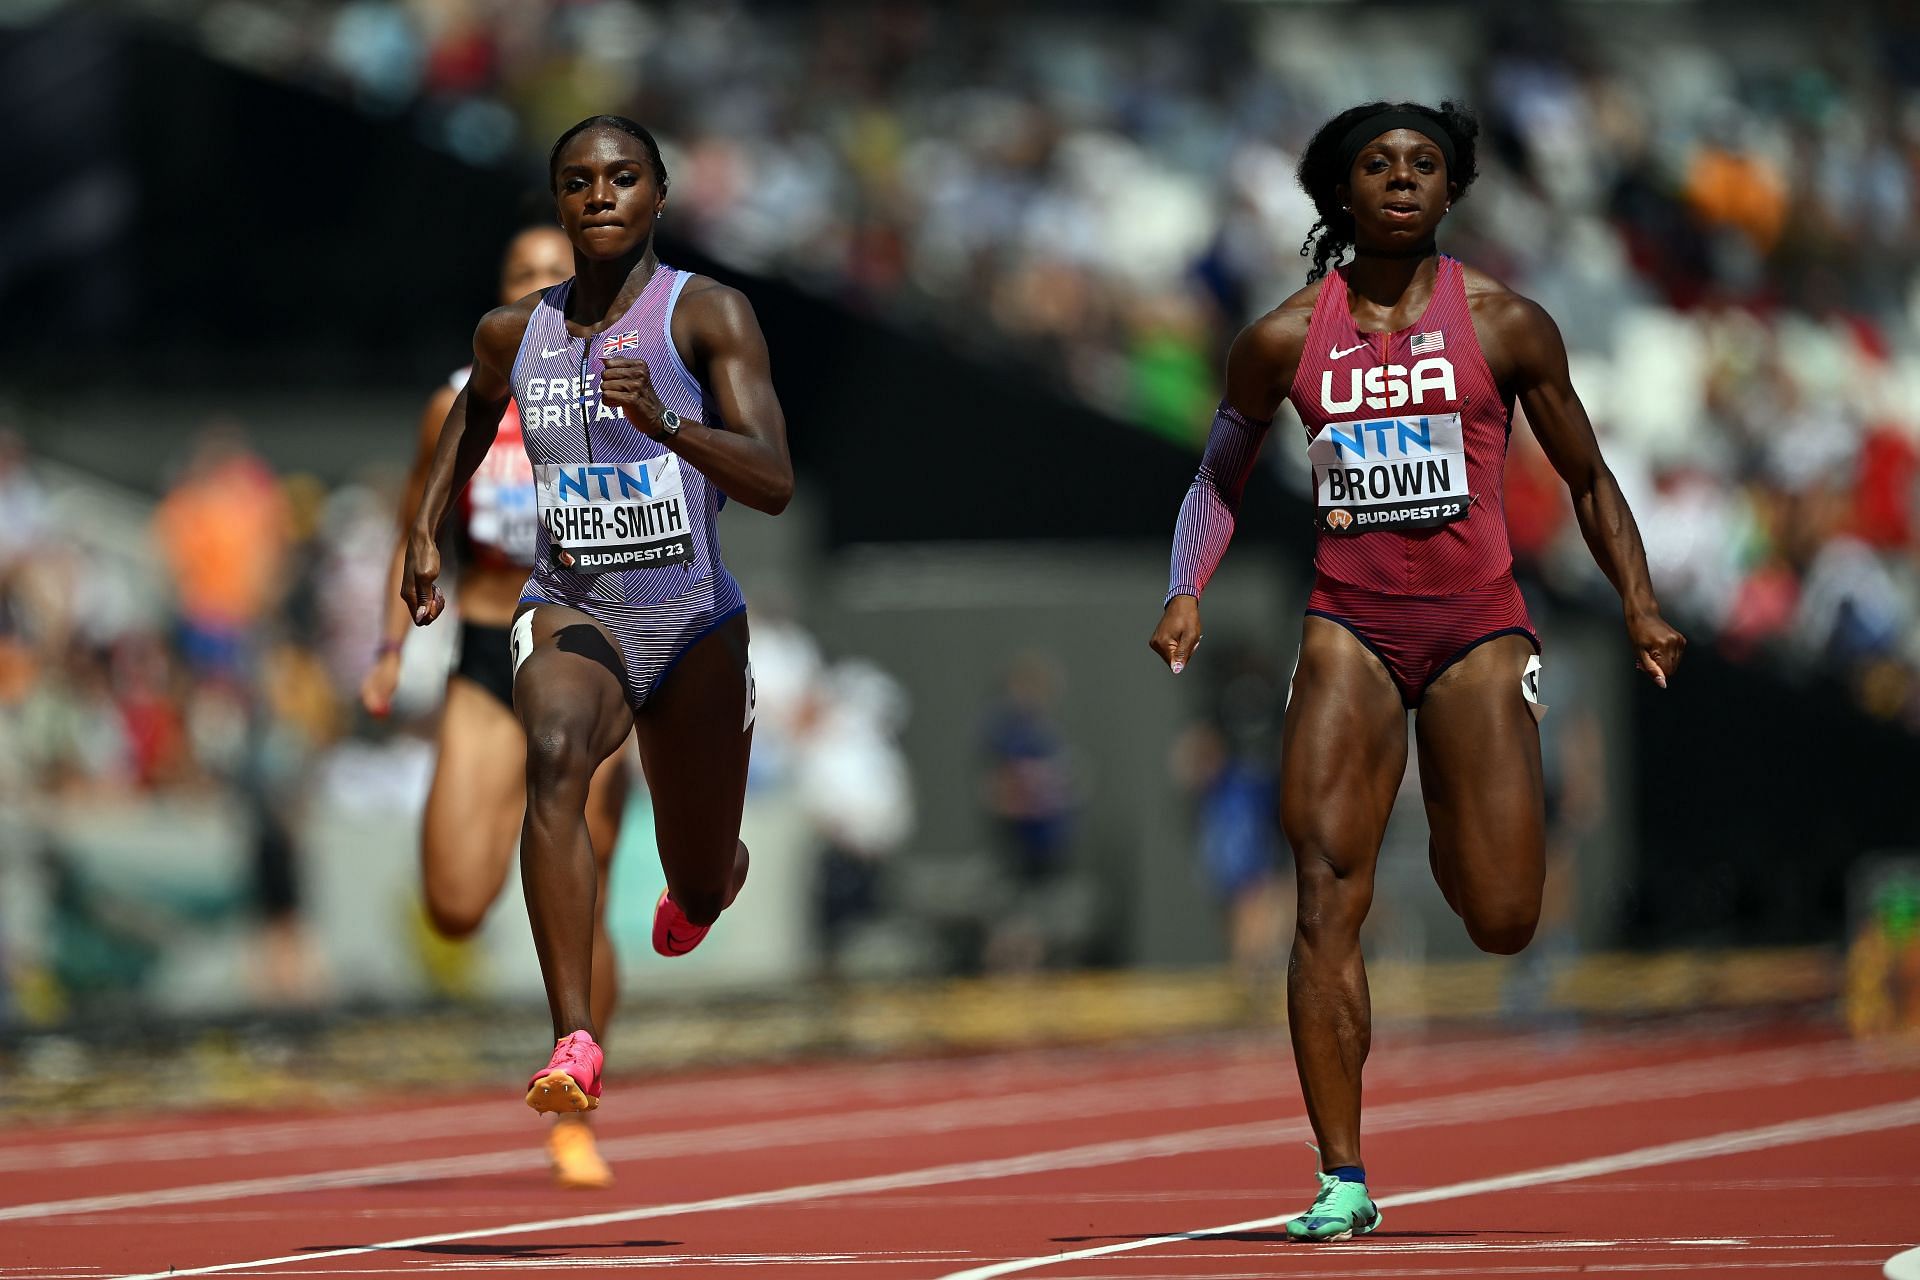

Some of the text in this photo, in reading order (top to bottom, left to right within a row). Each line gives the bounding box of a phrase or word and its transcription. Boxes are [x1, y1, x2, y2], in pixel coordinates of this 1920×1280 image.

[1321, 357, 1457, 414] USA
[1330, 417, 1432, 460] NTN
[559, 464, 652, 502] NTN
[1328, 458, 1451, 501] BROWN
[1356, 503, 1460, 525] BUDAPEST 23
[580, 542, 684, 566] BUDAPEST 23
